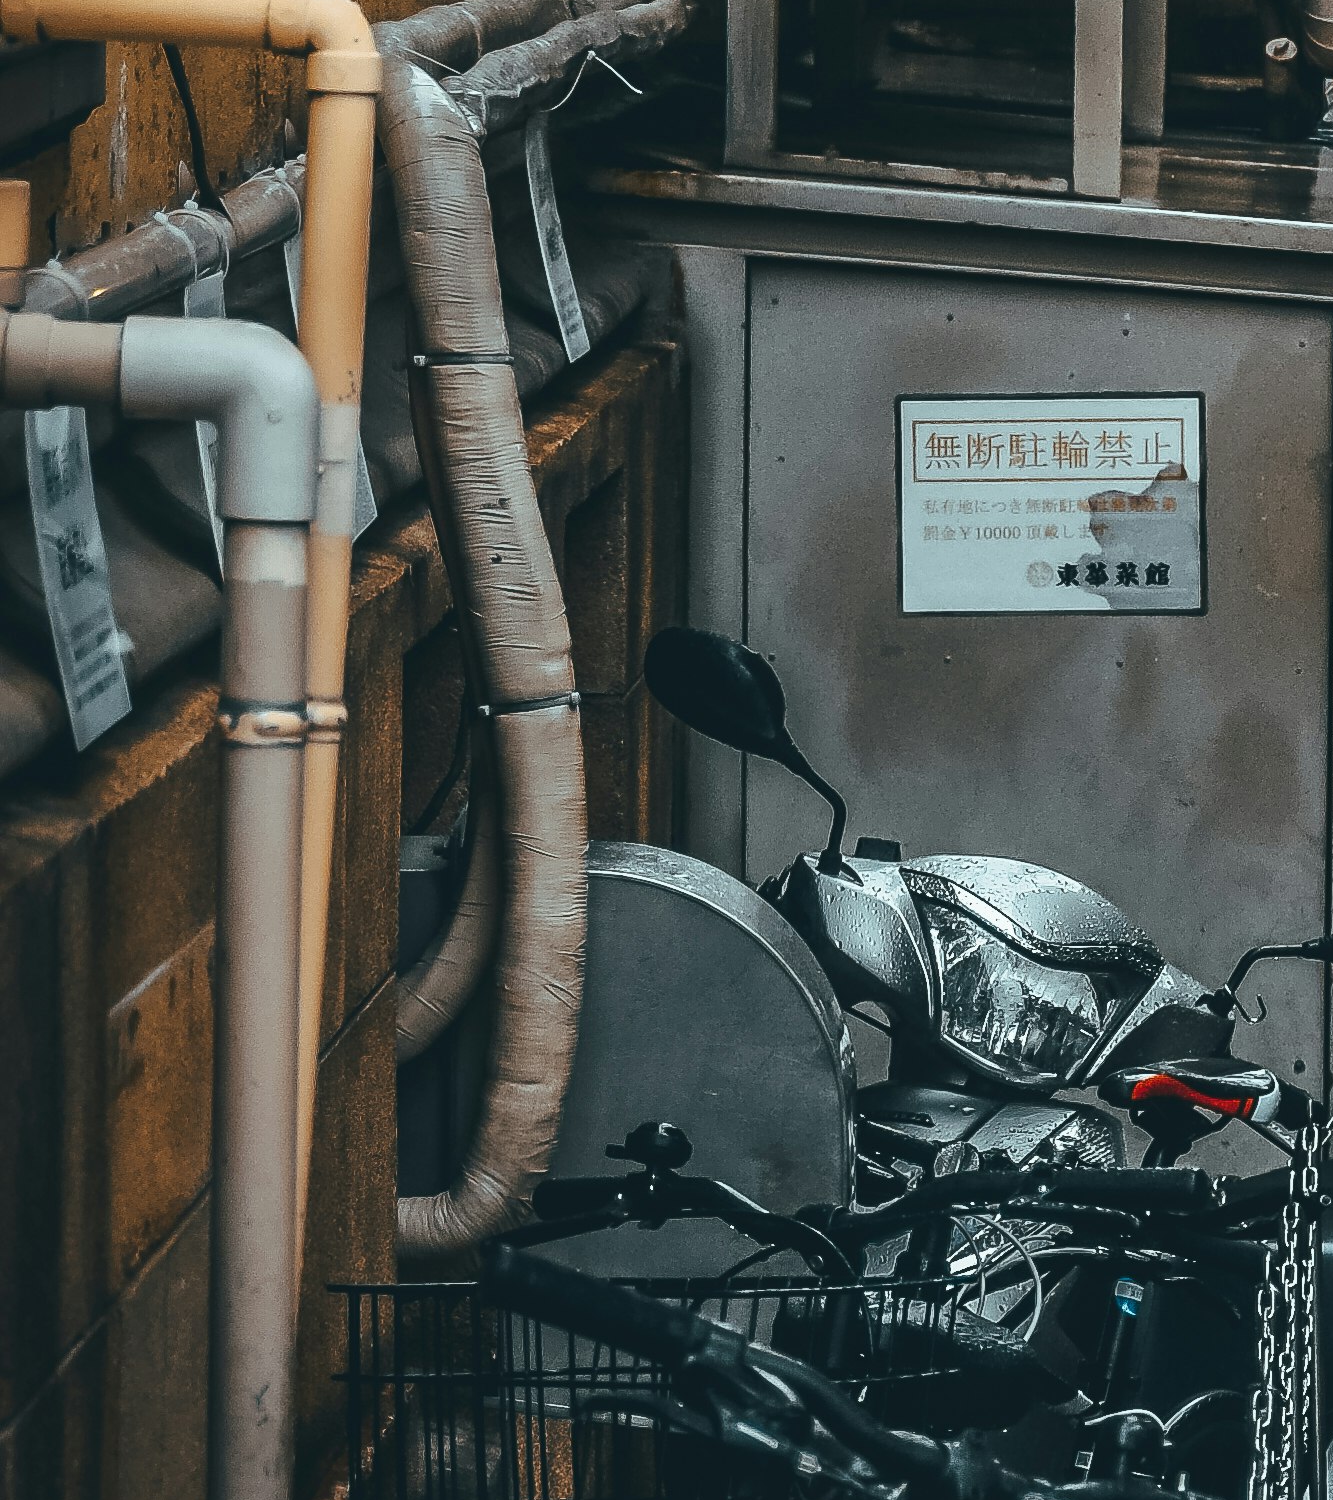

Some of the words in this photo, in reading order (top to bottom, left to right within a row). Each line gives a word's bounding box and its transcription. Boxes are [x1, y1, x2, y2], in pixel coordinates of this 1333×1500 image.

[923, 430, 1173, 470] 無断駐輪禁止
[1056, 560, 1172, 588] 東華菜館
